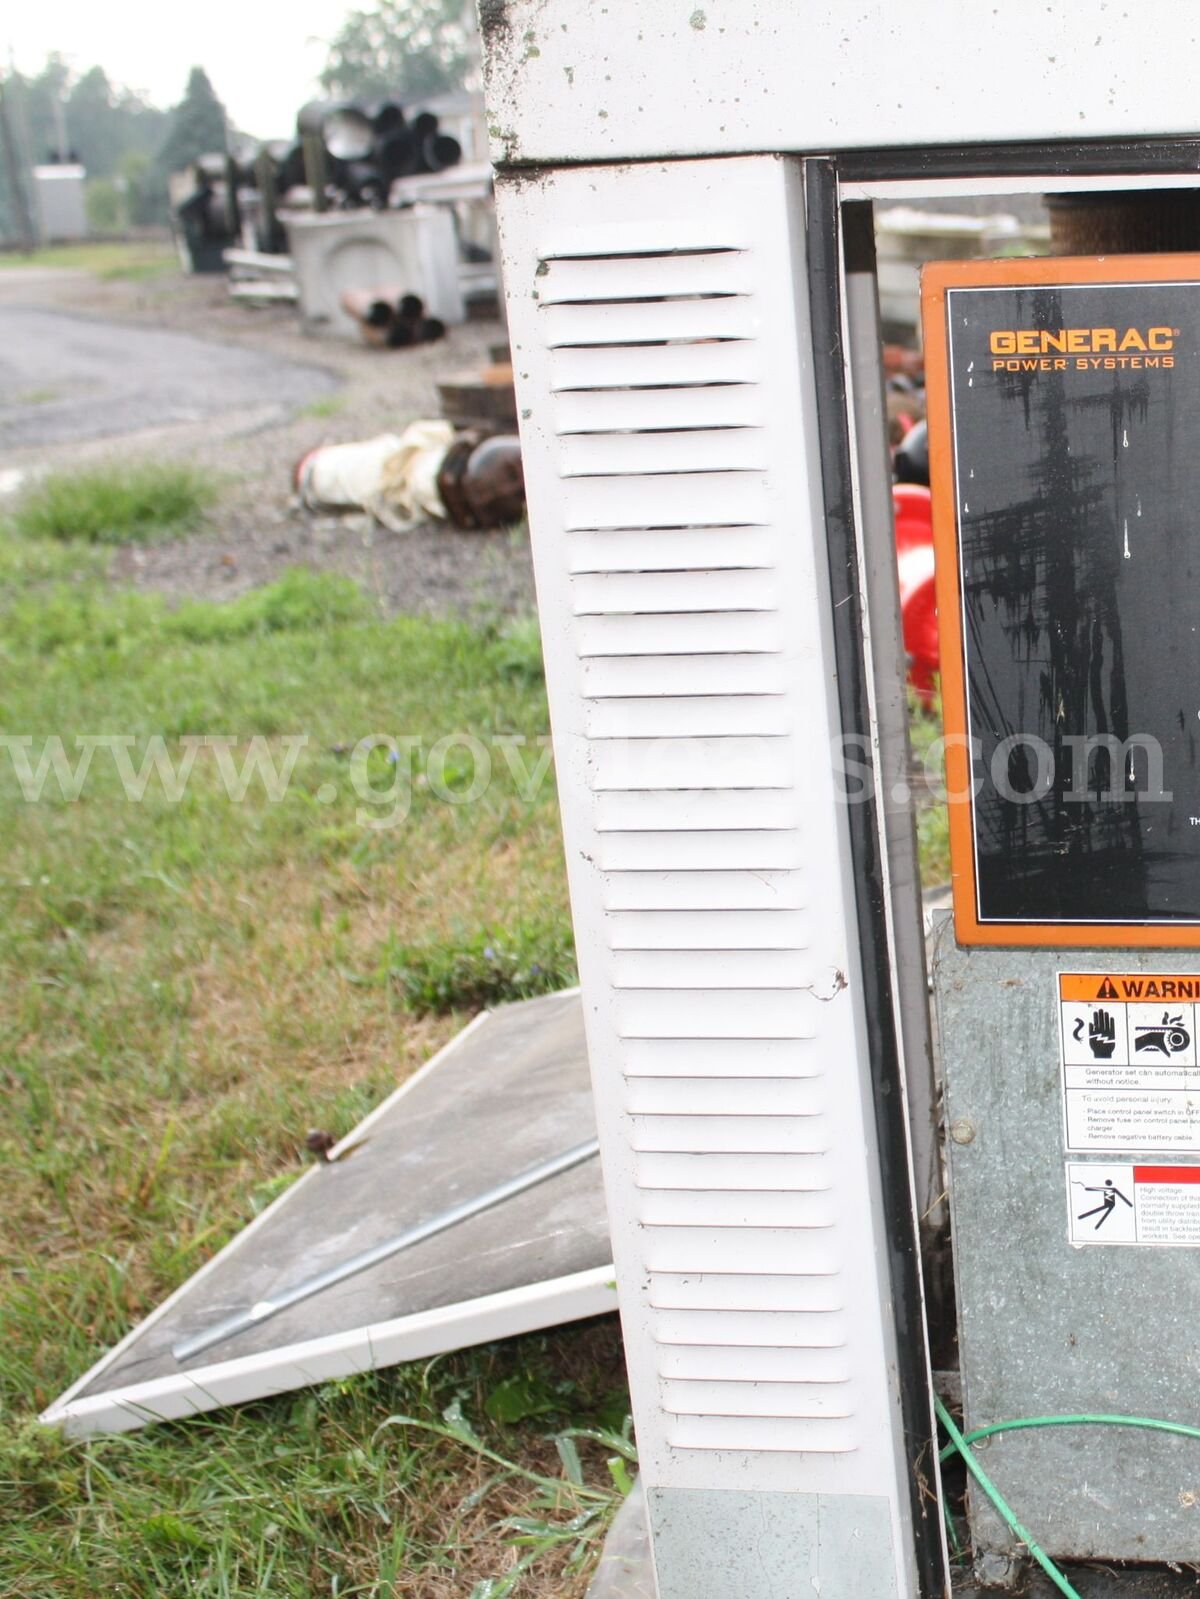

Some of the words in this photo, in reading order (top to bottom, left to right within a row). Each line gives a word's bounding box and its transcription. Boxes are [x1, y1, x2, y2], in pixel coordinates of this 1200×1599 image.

[990, 327, 1173, 354] GENERAC
[993, 359, 1066, 371] POWER
[1076, 357, 1175, 369] SYSTEMS
[1086, 1068, 1122, 1076] Generator
[1140, 1069, 1152, 1077] can
[1117, 1078, 1140, 1086] notice.
